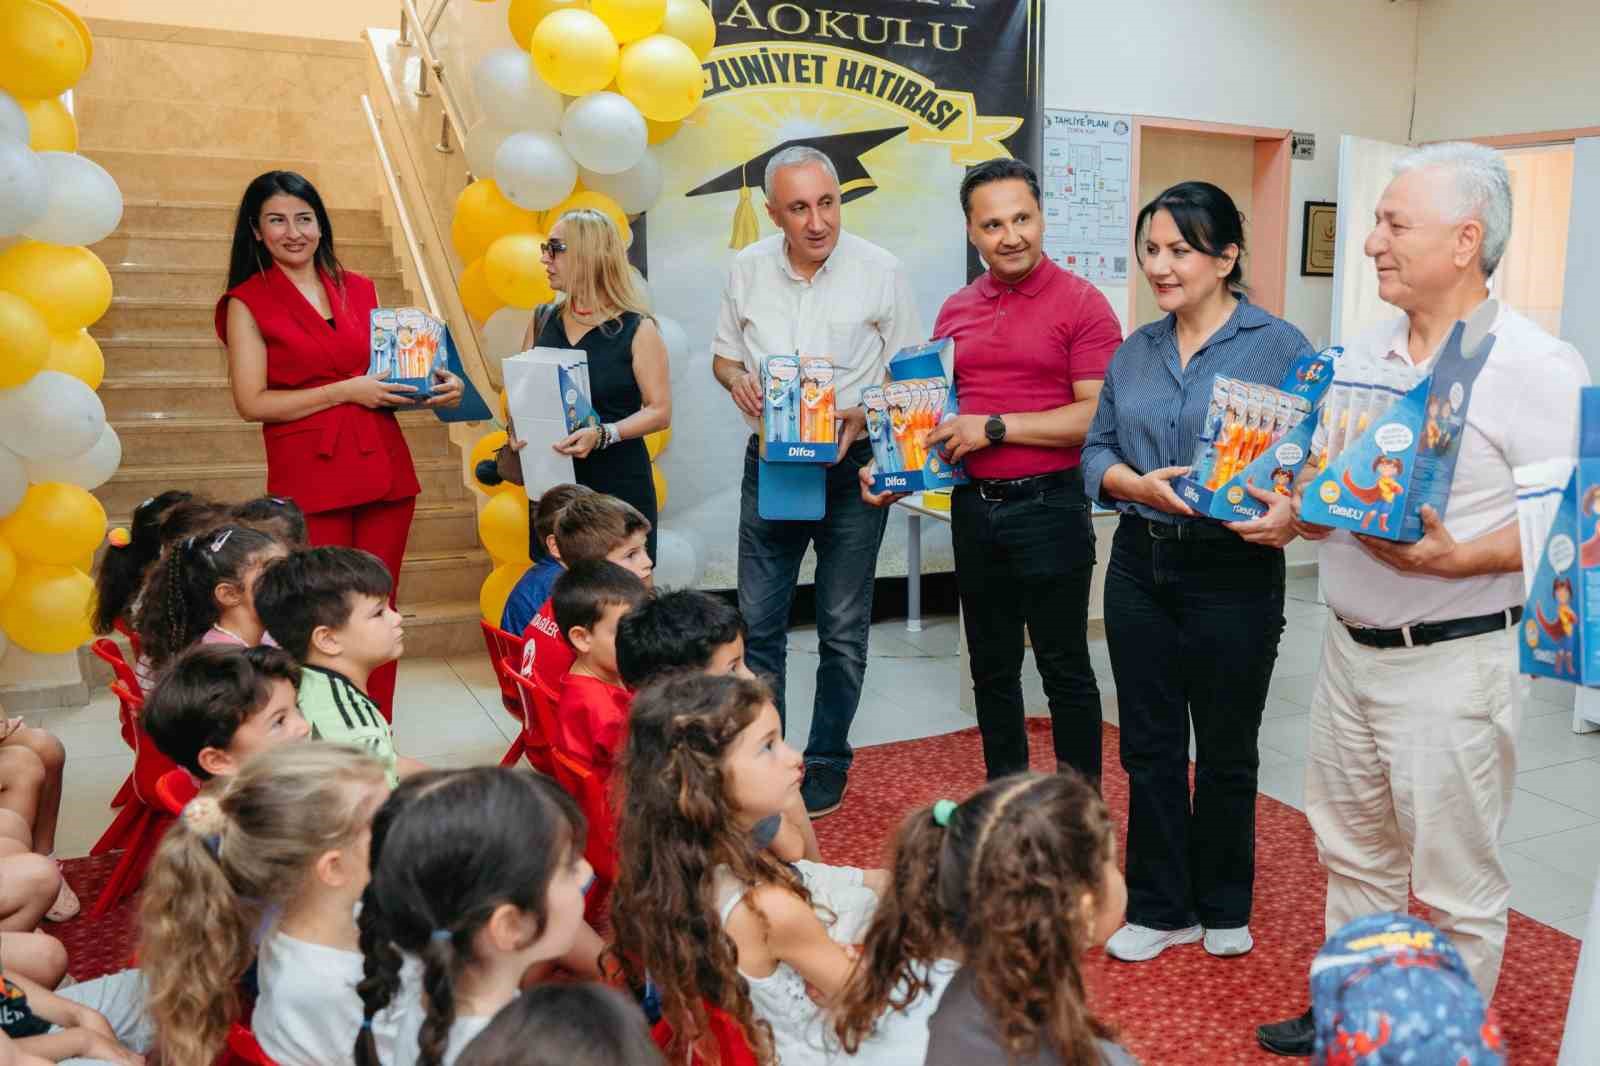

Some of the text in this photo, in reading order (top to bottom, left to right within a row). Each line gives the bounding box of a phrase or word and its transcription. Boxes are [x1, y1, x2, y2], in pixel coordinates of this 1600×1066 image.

[709, 0, 968, 51] AOKULU
[701, 47, 963, 131] ZUNİYET HATIRASI
